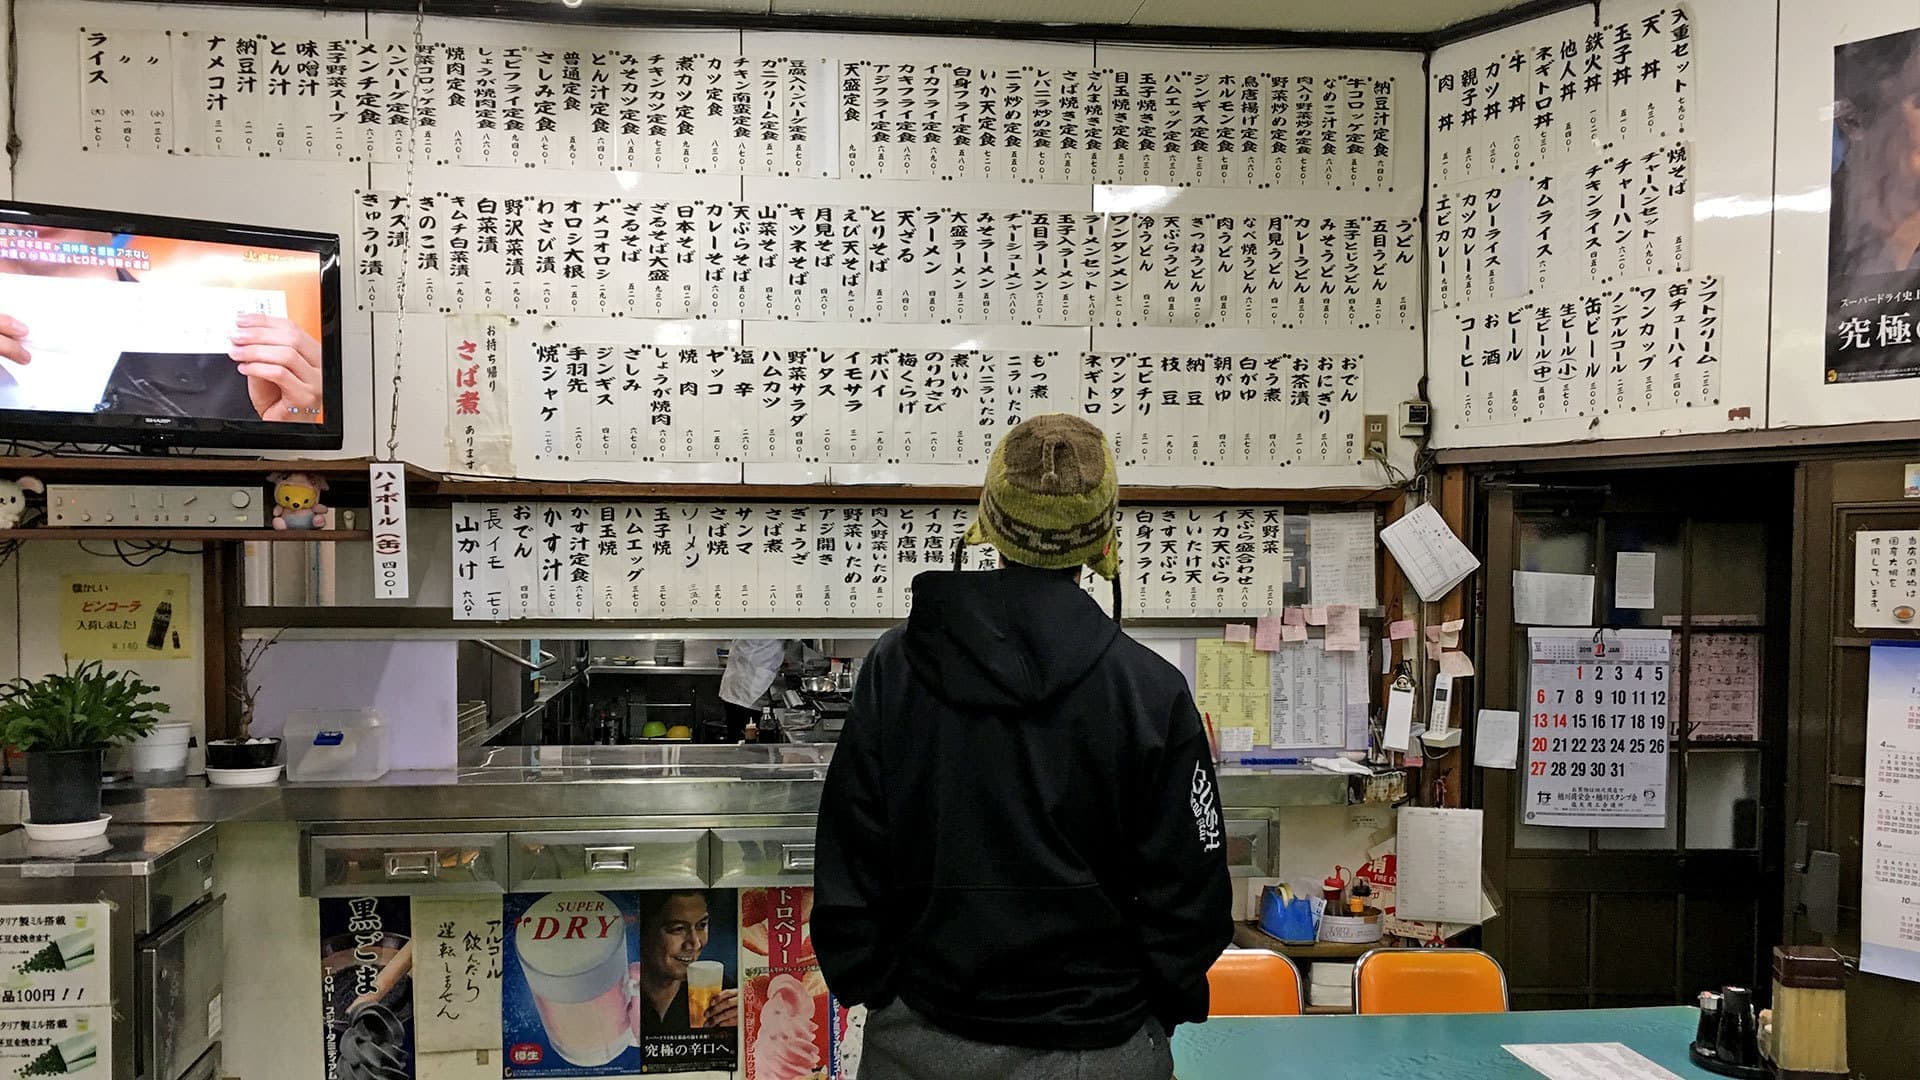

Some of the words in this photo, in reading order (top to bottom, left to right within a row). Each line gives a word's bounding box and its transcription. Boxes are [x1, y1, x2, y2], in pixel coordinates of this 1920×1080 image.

[88, 33, 108, 83] ライス
[236, 38, 257, 93] 納豆汁
[356, 44, 381, 124] メンチ定食
[445, 47, 465, 106] 焼肉定食
[502, 49, 524, 130] エビフライ定食
[562, 51, 581, 110] 普通定食
[706, 58, 723, 116] カツ定食
[1532, 47, 1554, 129] ネギトロ丼
[1584, 32, 1604, 93] 鉄火丼
[1612, 23, 1632, 86] 玉子丼
[590, 53, 610, 133] とん汁定食
[620, 54, 640, 135] みそカツ定食
[647, 54, 667, 136] チキンカツ定食
[676, 55, 697, 135] 煮カツ定食
[843, 63, 860, 121] 天盛定食
[871, 65, 890, 142] アジフライ定食
[896, 64, 916, 143] カキフライ定食
[922, 65, 941, 143] イカフライ定食
[952, 67, 971, 146] 白身フライ定食
[978, 69, 996, 146] いか天定食
[1004, 71, 1023, 147] ニラ炒め定食
[1059, 70, 1079, 149] さば焼き定食
[1112, 72, 1130, 150] 目玉焼き定食
[1163, 75, 1182, 153] ハムエッグ定食
[1217, 75, 1235, 152] ホルモン定食
[1271, 77, 1289, 153] 野菜炒め定食
[1346, 78, 1367, 154] 牛コロッケ定食
[1373, 81, 1390, 157] 納豆汁定食
[1585, 165, 1603, 249] チキンライス
[1667, 147, 1687, 196] 焼そば
[418, 197, 438, 270] きのこ漬
[450, 196, 469, 277] キムチ白菜漬
[477, 198, 498, 253] 白菜漬
[505, 199, 524, 275] 野沢菜漬
[536, 200, 556, 273] わさび漬
[564, 200, 585, 278] オロシ大根
[594, 202, 610, 279] ナメコオロシ
[621, 203, 642, 262] ざるそば
[676, 206, 695, 263] 日本そば
[705, 204, 725, 281] カレーそば
[733, 206, 751, 282] 天ぷらそば
[758, 206, 778, 268] 山菜そば
[789, 208, 809, 285] キツネそば
[815, 208, 835, 267] 月見そば
[869, 210, 890, 272] とりそば
[897, 211, 916, 263] 天ざる
[923, 212, 941, 274] ラーメン
[950, 212, 968, 289] 大盛ラーメン
[977, 213, 995, 288] みそラーメン
[1057, 214, 1076, 289] 玉子入ラーメン
[1110, 215, 1129, 291] ワンタンメン
[1138, 216, 1155, 271] 冷うどん
[1163, 216, 1180, 289] 天ぷらうどん
[1217, 217, 1233, 272] 肉うどん
[1268, 217, 1284, 290] 月見うどん
[1396, 220, 1414, 263] うどん
[1436, 198, 1451, 274] エビカレー
[1462, 194, 1476, 272] カツカレー
[1485, 189, 1501, 267] カレーライス
[1536, 177, 1554, 258] オムライス
[1294, 218, 1310, 293] カレーうどん
[1461, 318, 1475, 386] コーヒー
[1668, 284, 1688, 368] 缶チューハイ
[1697, 276, 1717, 364] ソフトクリーム
[1838, 312, 1920, 351] 究極
[456, 339, 481, 415] さば煮
[486, 325, 498, 393] お持ち帰り
[567, 347, 588, 392] 手羽先
[623, 348, 641, 391] さしみ
[651, 348, 671, 425] しょうが焼肉
[762, 351, 782, 408] ハムカツ
[788, 351, 807, 427] 野菜サラダ
[818, 351, 835, 396] レタス
[925, 352, 946, 413] のりわさび
[951, 354, 969, 398] 煮いか
[1030, 355, 1048, 398] もつ煮
[1085, 355, 1103, 413] ネギトロ
[1137, 357, 1153, 415] エビチリ
[1214, 356, 1232, 401] 朝がゆ
[1291, 358, 1310, 406] お茶漬
[1318, 357, 1335, 424] おにぎり
[464, 425, 475, 470] あります
[456, 516, 479, 580] 山かけ
[567, 505, 592, 582] かす汁定食
[650, 506, 673, 555] 玉子焼
[679, 506, 702, 568] ソーメン
[732, 506, 756, 554] サンマ
[788, 505, 813, 564] ぎょうざ
[841, 506, 865, 583] 野菜いため
[921, 507, 946, 563] イカ唐揚
[1133, 508, 1156, 584] 白身フライ
[1209, 508, 1233, 583] イカ天ぷら
[1260, 508, 1281, 553] 天野菜
[1577, 667, 1583, 679] 1
[1595, 666, 1603, 680] 2
[1615, 667, 1623, 681] 3
[1635, 667, 1643, 680] 4
[1655, 667, 1663, 681] 5
[1533, 714, 1547, 728] 13
[1553, 715, 1567, 728] 14
[1572, 715, 1586, 728] 15
[1592, 715, 1606, 729] 16
[1611, 715, 1625, 729] 17
[1631, 715, 1645, 729] 18
[1651, 715, 1665, 729] 19
[1531, 762, 1546, 775] 27
[1551, 763, 1566, 776] 28
[1571, 763, 1586, 776] 29
[1590, 763, 1605, 776] 30
[1611, 763, 1625, 777] 31
[556, 901, 606, 913] SUPER
[774, 886, 797, 964] トロベリー
[348, 897, 383, 996] 黒ごま
[436, 921, 460, 1020] 運転しません
[463, 930, 483, 1003] 飲んだら
[486, 919, 504, 979] アルコール
